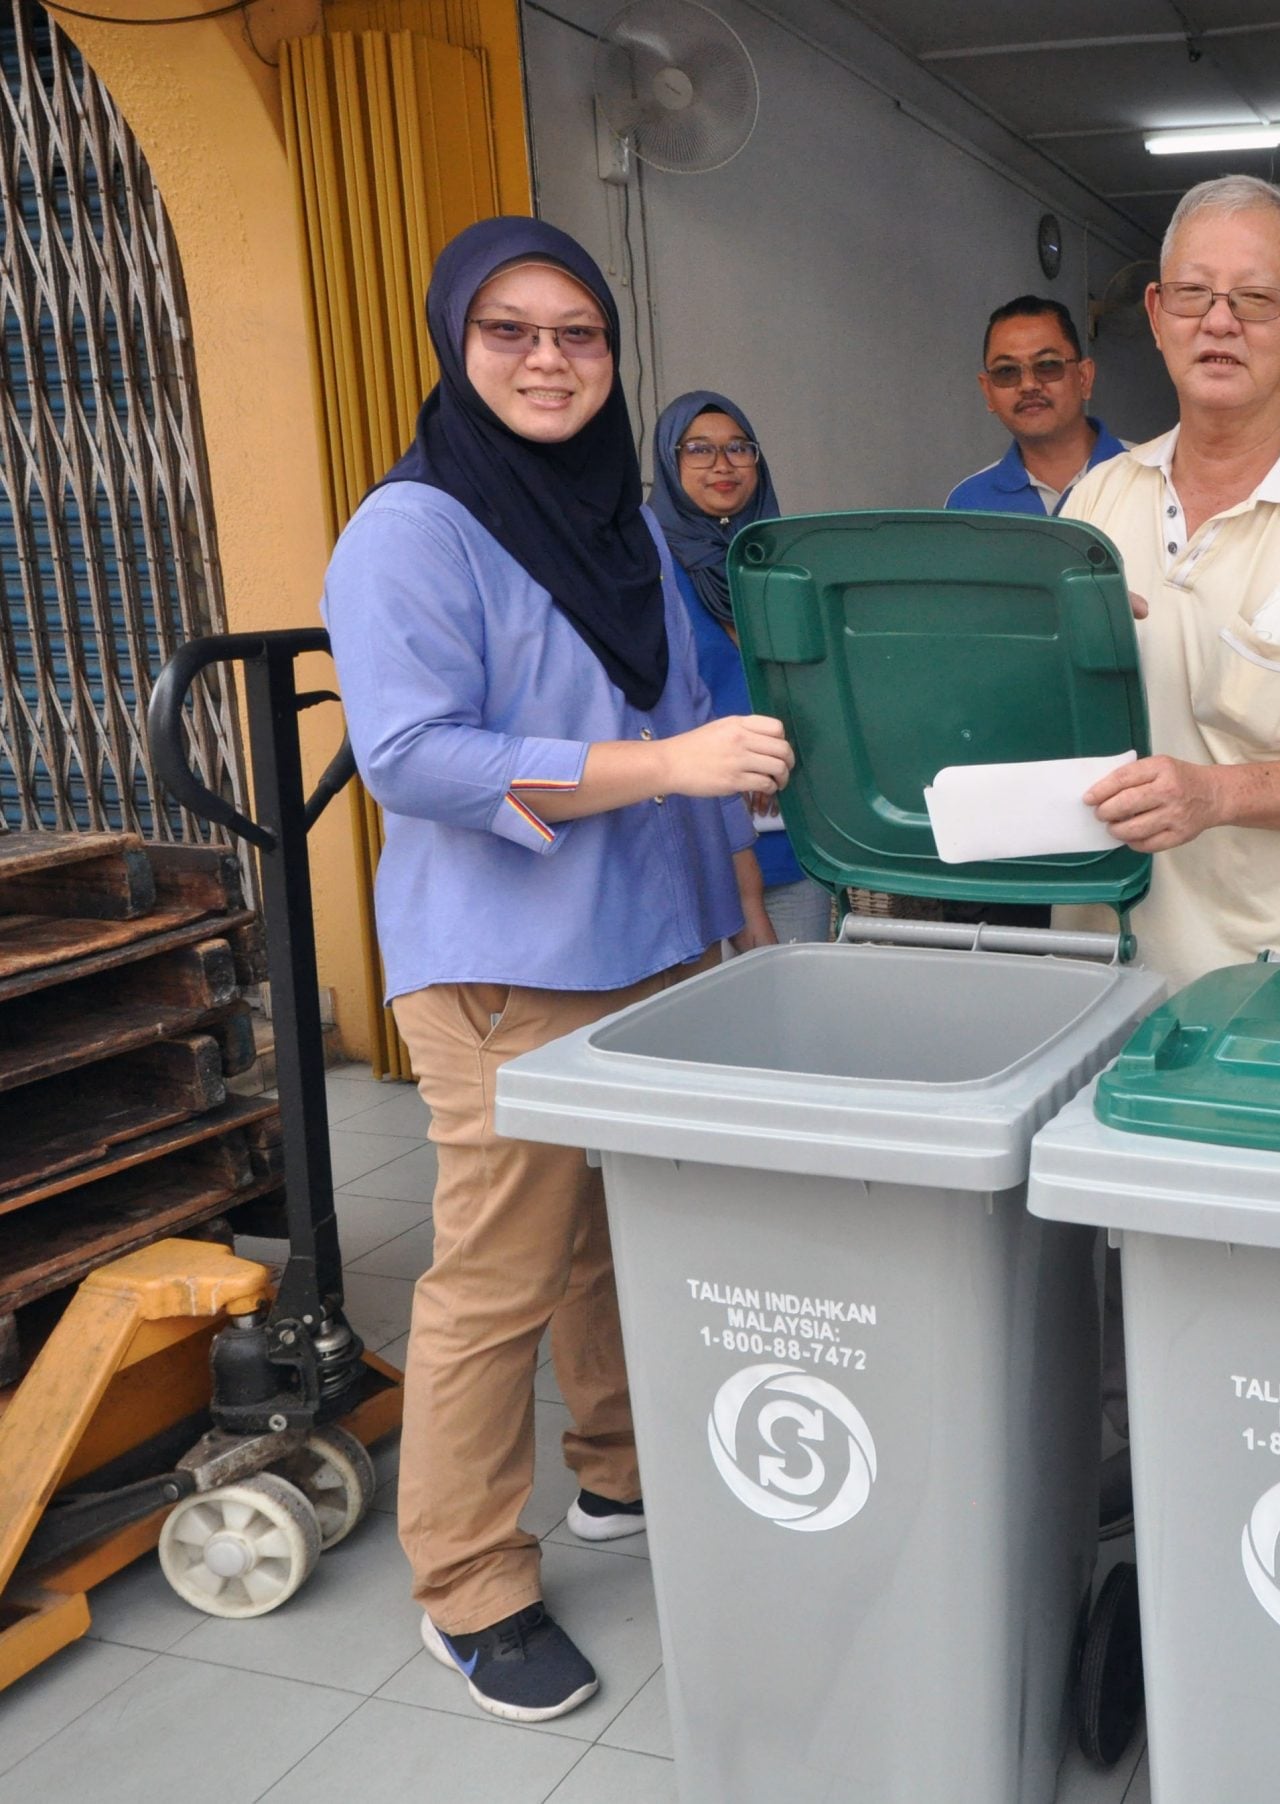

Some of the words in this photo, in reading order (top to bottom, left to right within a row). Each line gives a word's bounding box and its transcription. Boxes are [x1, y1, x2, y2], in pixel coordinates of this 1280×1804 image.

[686, 1278, 760, 1309] TALIAN
[764, 1290, 877, 1325] INDAHKAN
[727, 1307, 840, 1343] MALAYSIA:
[699, 1326, 867, 1371] 1-800-88-7472
